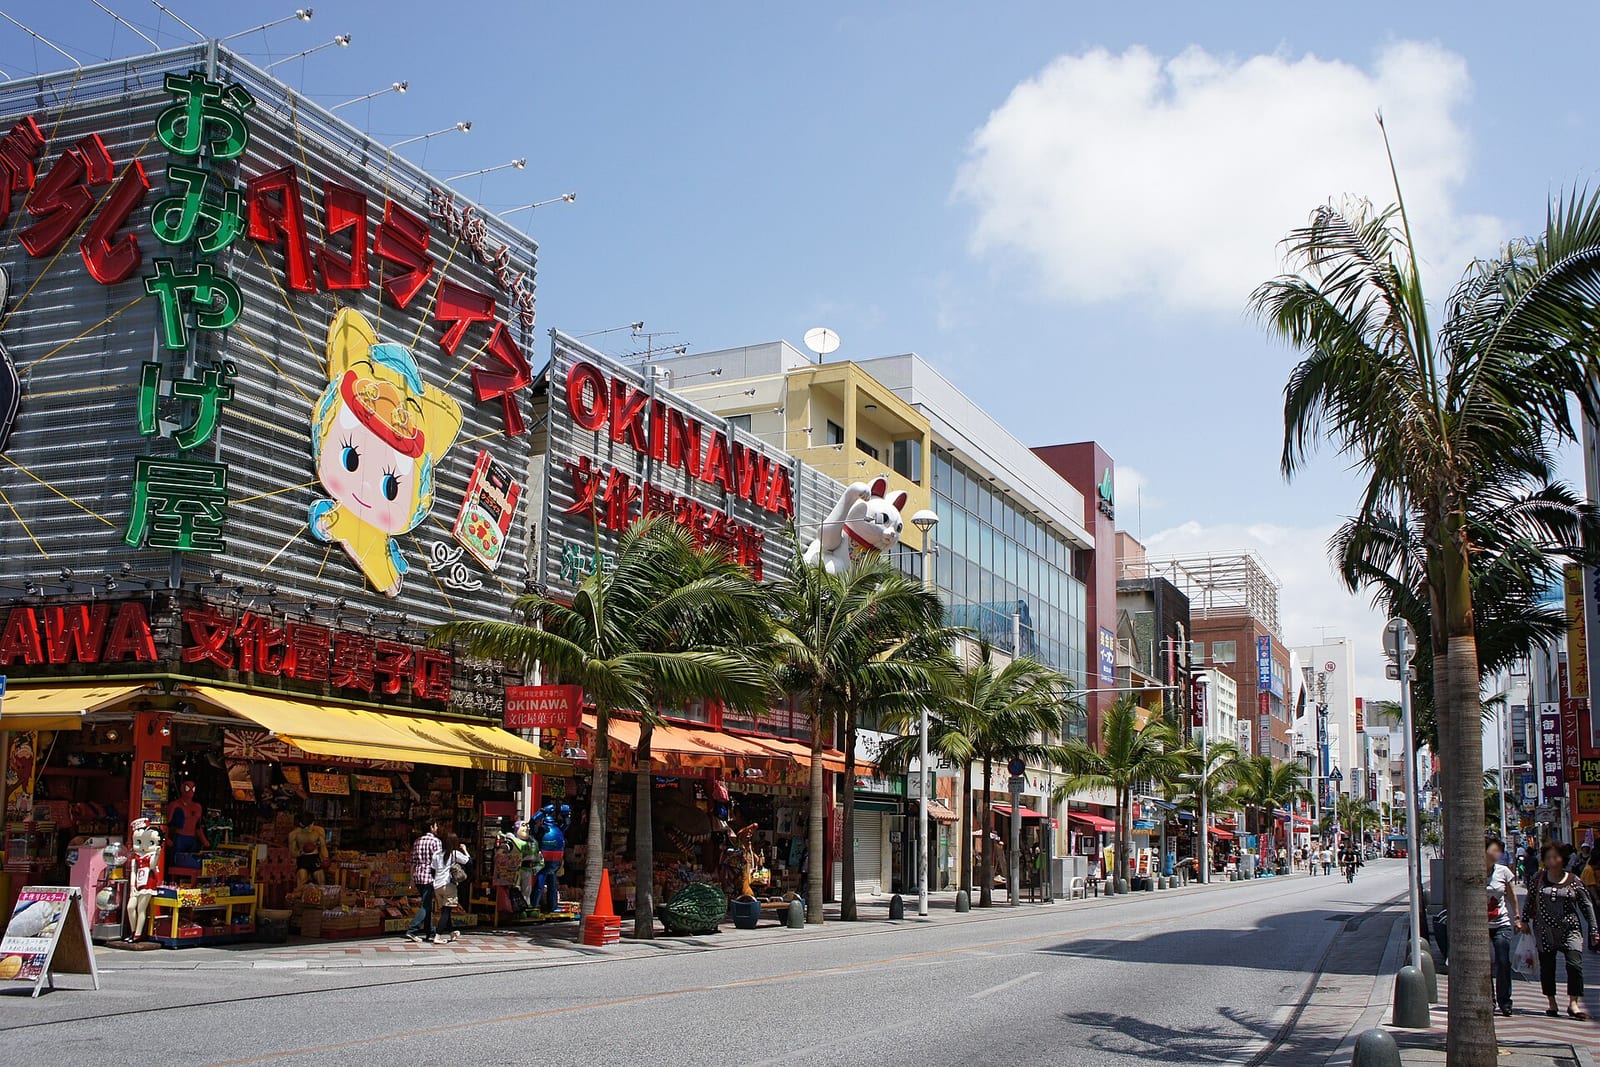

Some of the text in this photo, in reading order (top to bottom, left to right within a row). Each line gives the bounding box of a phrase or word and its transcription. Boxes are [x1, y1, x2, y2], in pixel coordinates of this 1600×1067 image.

[123, 71, 255, 553] おみやげ屋
[246, 164, 533, 437] タコライス
[566, 360, 796, 520] OKINAWA
[181, 603, 452, 701] 文化屋菓子店
[507, 699, 568, 711] OKINAWA
[1542, 719, 1558, 787] 御菓子御殿
